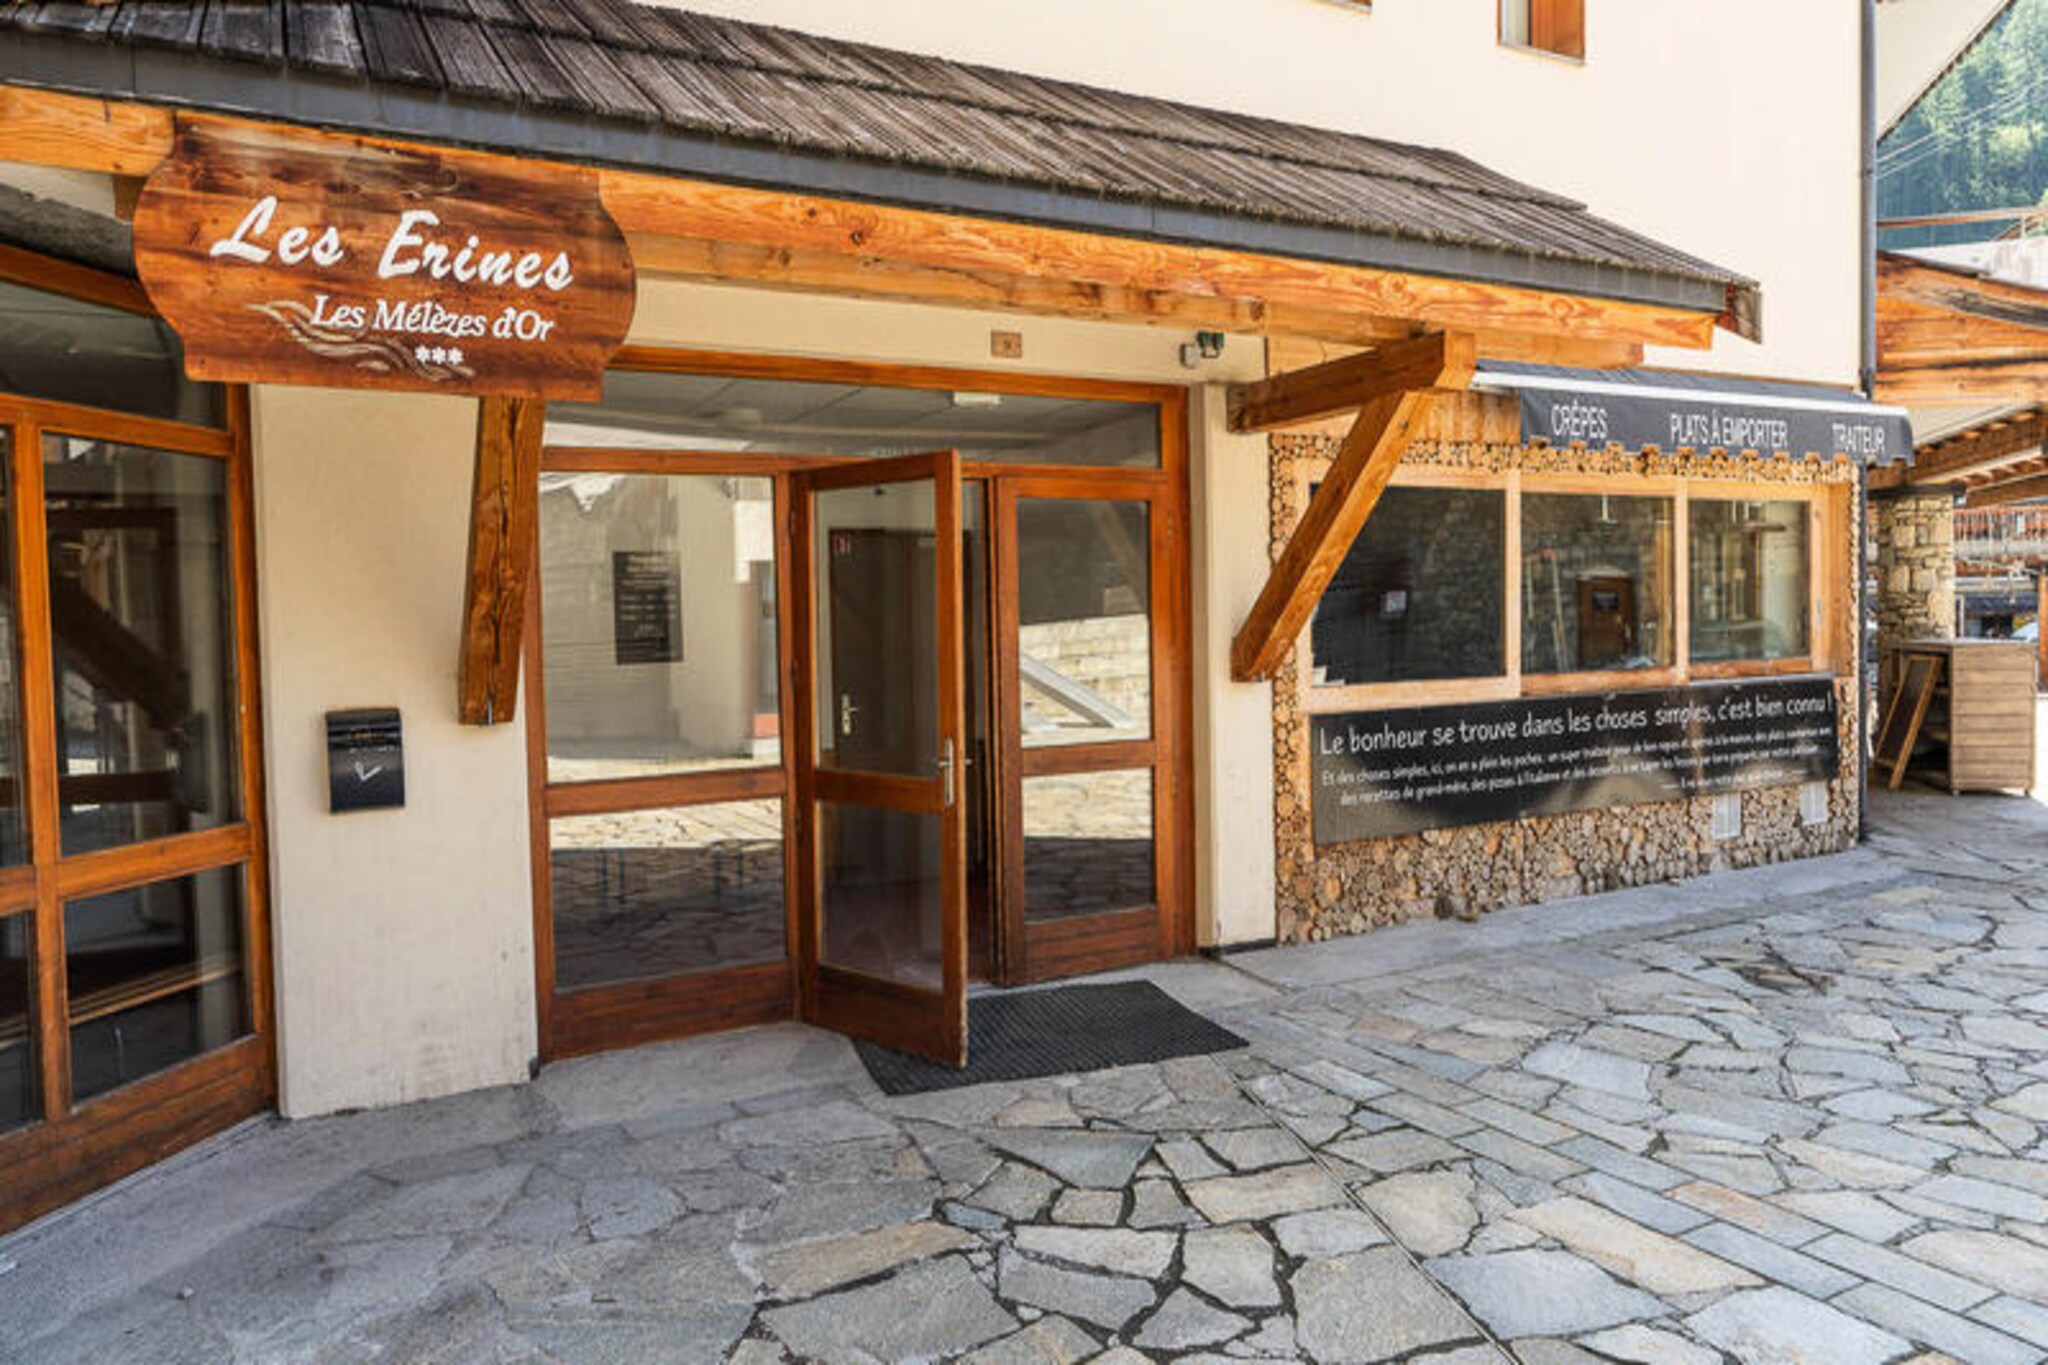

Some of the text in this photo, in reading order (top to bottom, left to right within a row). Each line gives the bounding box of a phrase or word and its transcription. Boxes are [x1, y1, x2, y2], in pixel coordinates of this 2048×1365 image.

[209, 194, 575, 291] Les Erines
[310, 294, 556, 342] Les Mélèzes d'Or
[1550, 399, 1608, 440] CRÊPES
[1670, 409, 1789, 449] PLATS À EMPORTER
[1832, 423, 1886, 453] TRAITEUR
[1320, 727, 1344, 754] Le
[1350, 722, 1427, 753] bonheur
[1433, 726, 1455, 746] se
[1460, 719, 1516, 743] trouve
[1522, 710, 1564, 737] dans
[1568, 708, 1591, 733] les
[1595, 705, 1647, 730] choses
[1655, 699, 1715, 729] simples,
[1718, 696, 1753, 721] c'est
[1755, 693, 1785, 717] bien
